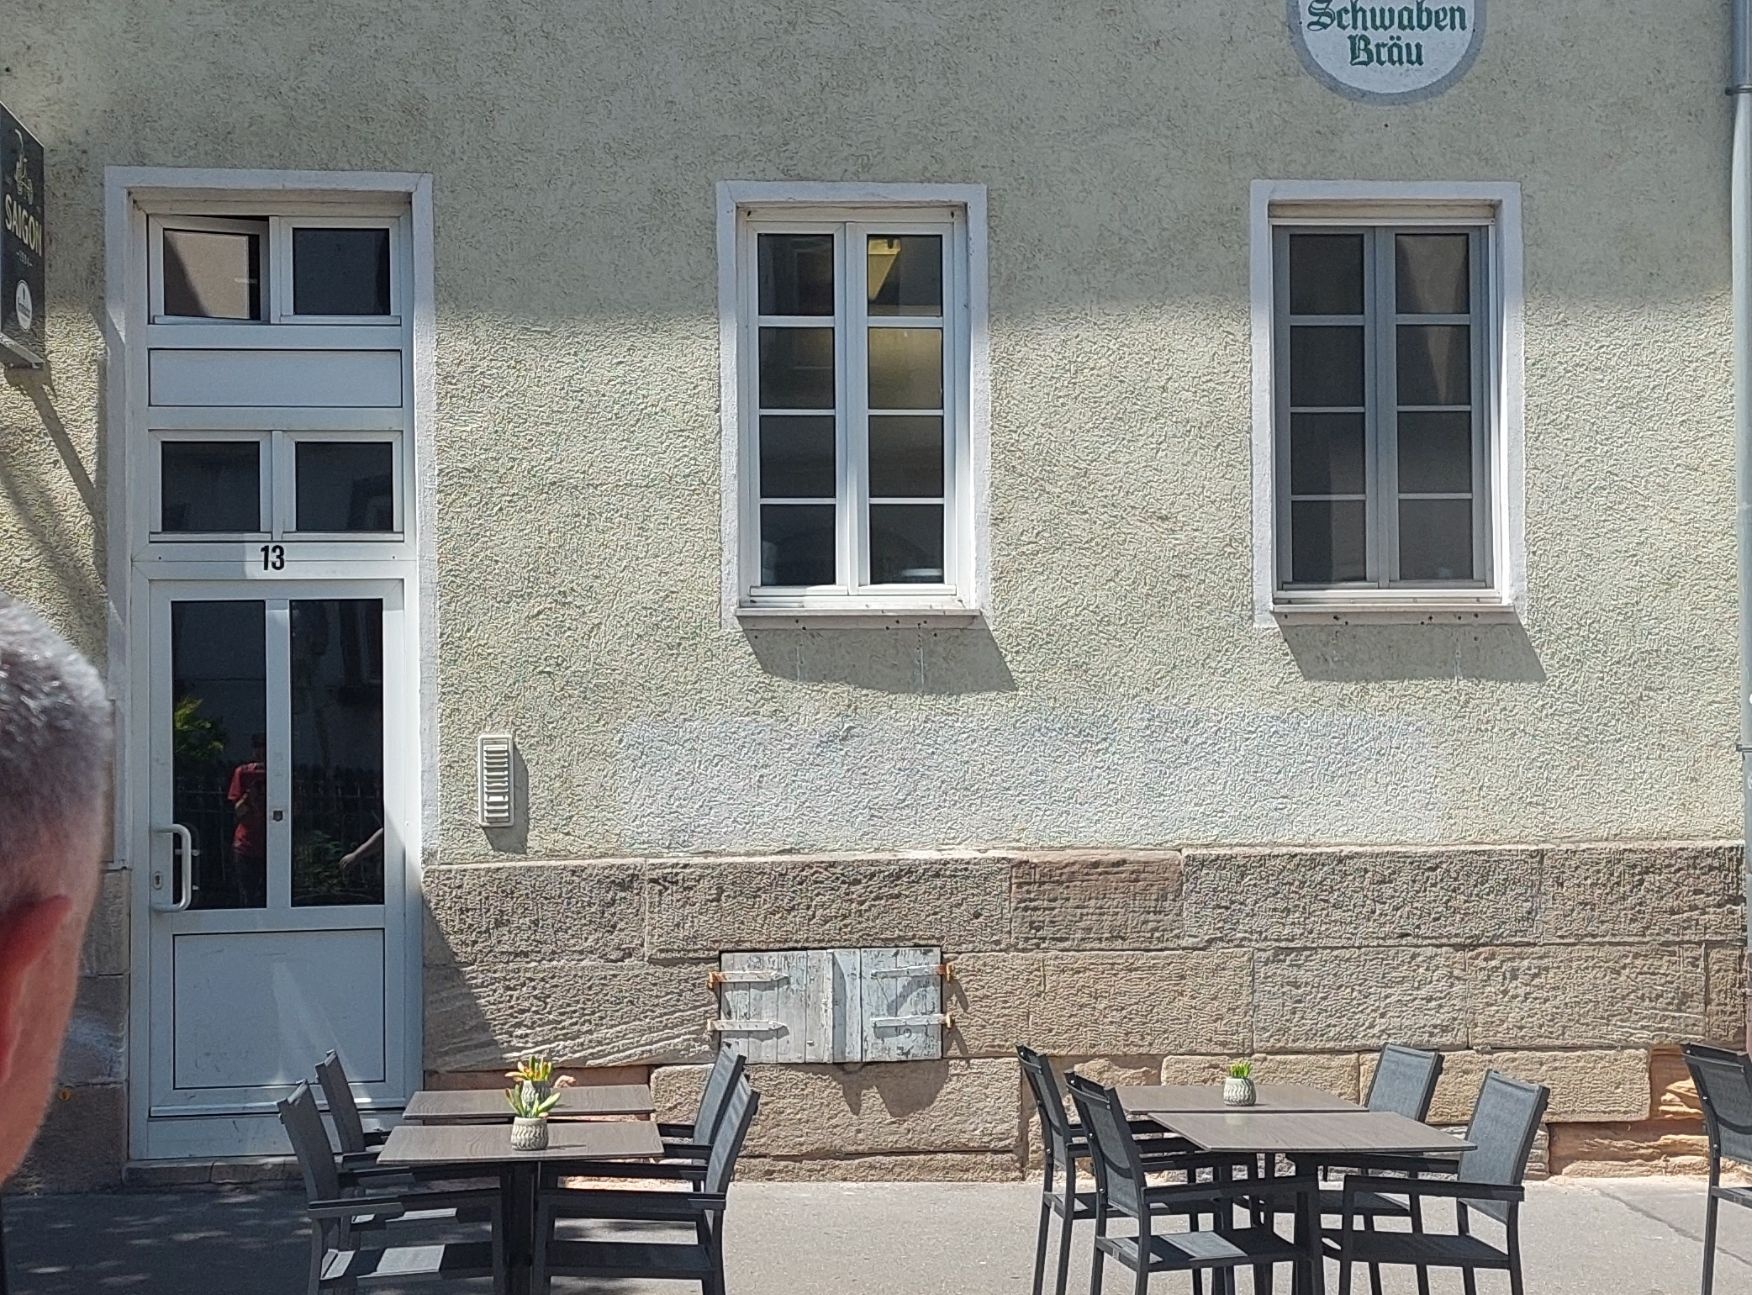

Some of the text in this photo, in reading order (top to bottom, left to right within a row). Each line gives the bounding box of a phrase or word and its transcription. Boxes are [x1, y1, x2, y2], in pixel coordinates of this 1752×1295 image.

[1347, 34, 1424, 66] Bräu
[5, 194, 42, 256] SAIGON
[261, 545, 285, 571] 13
